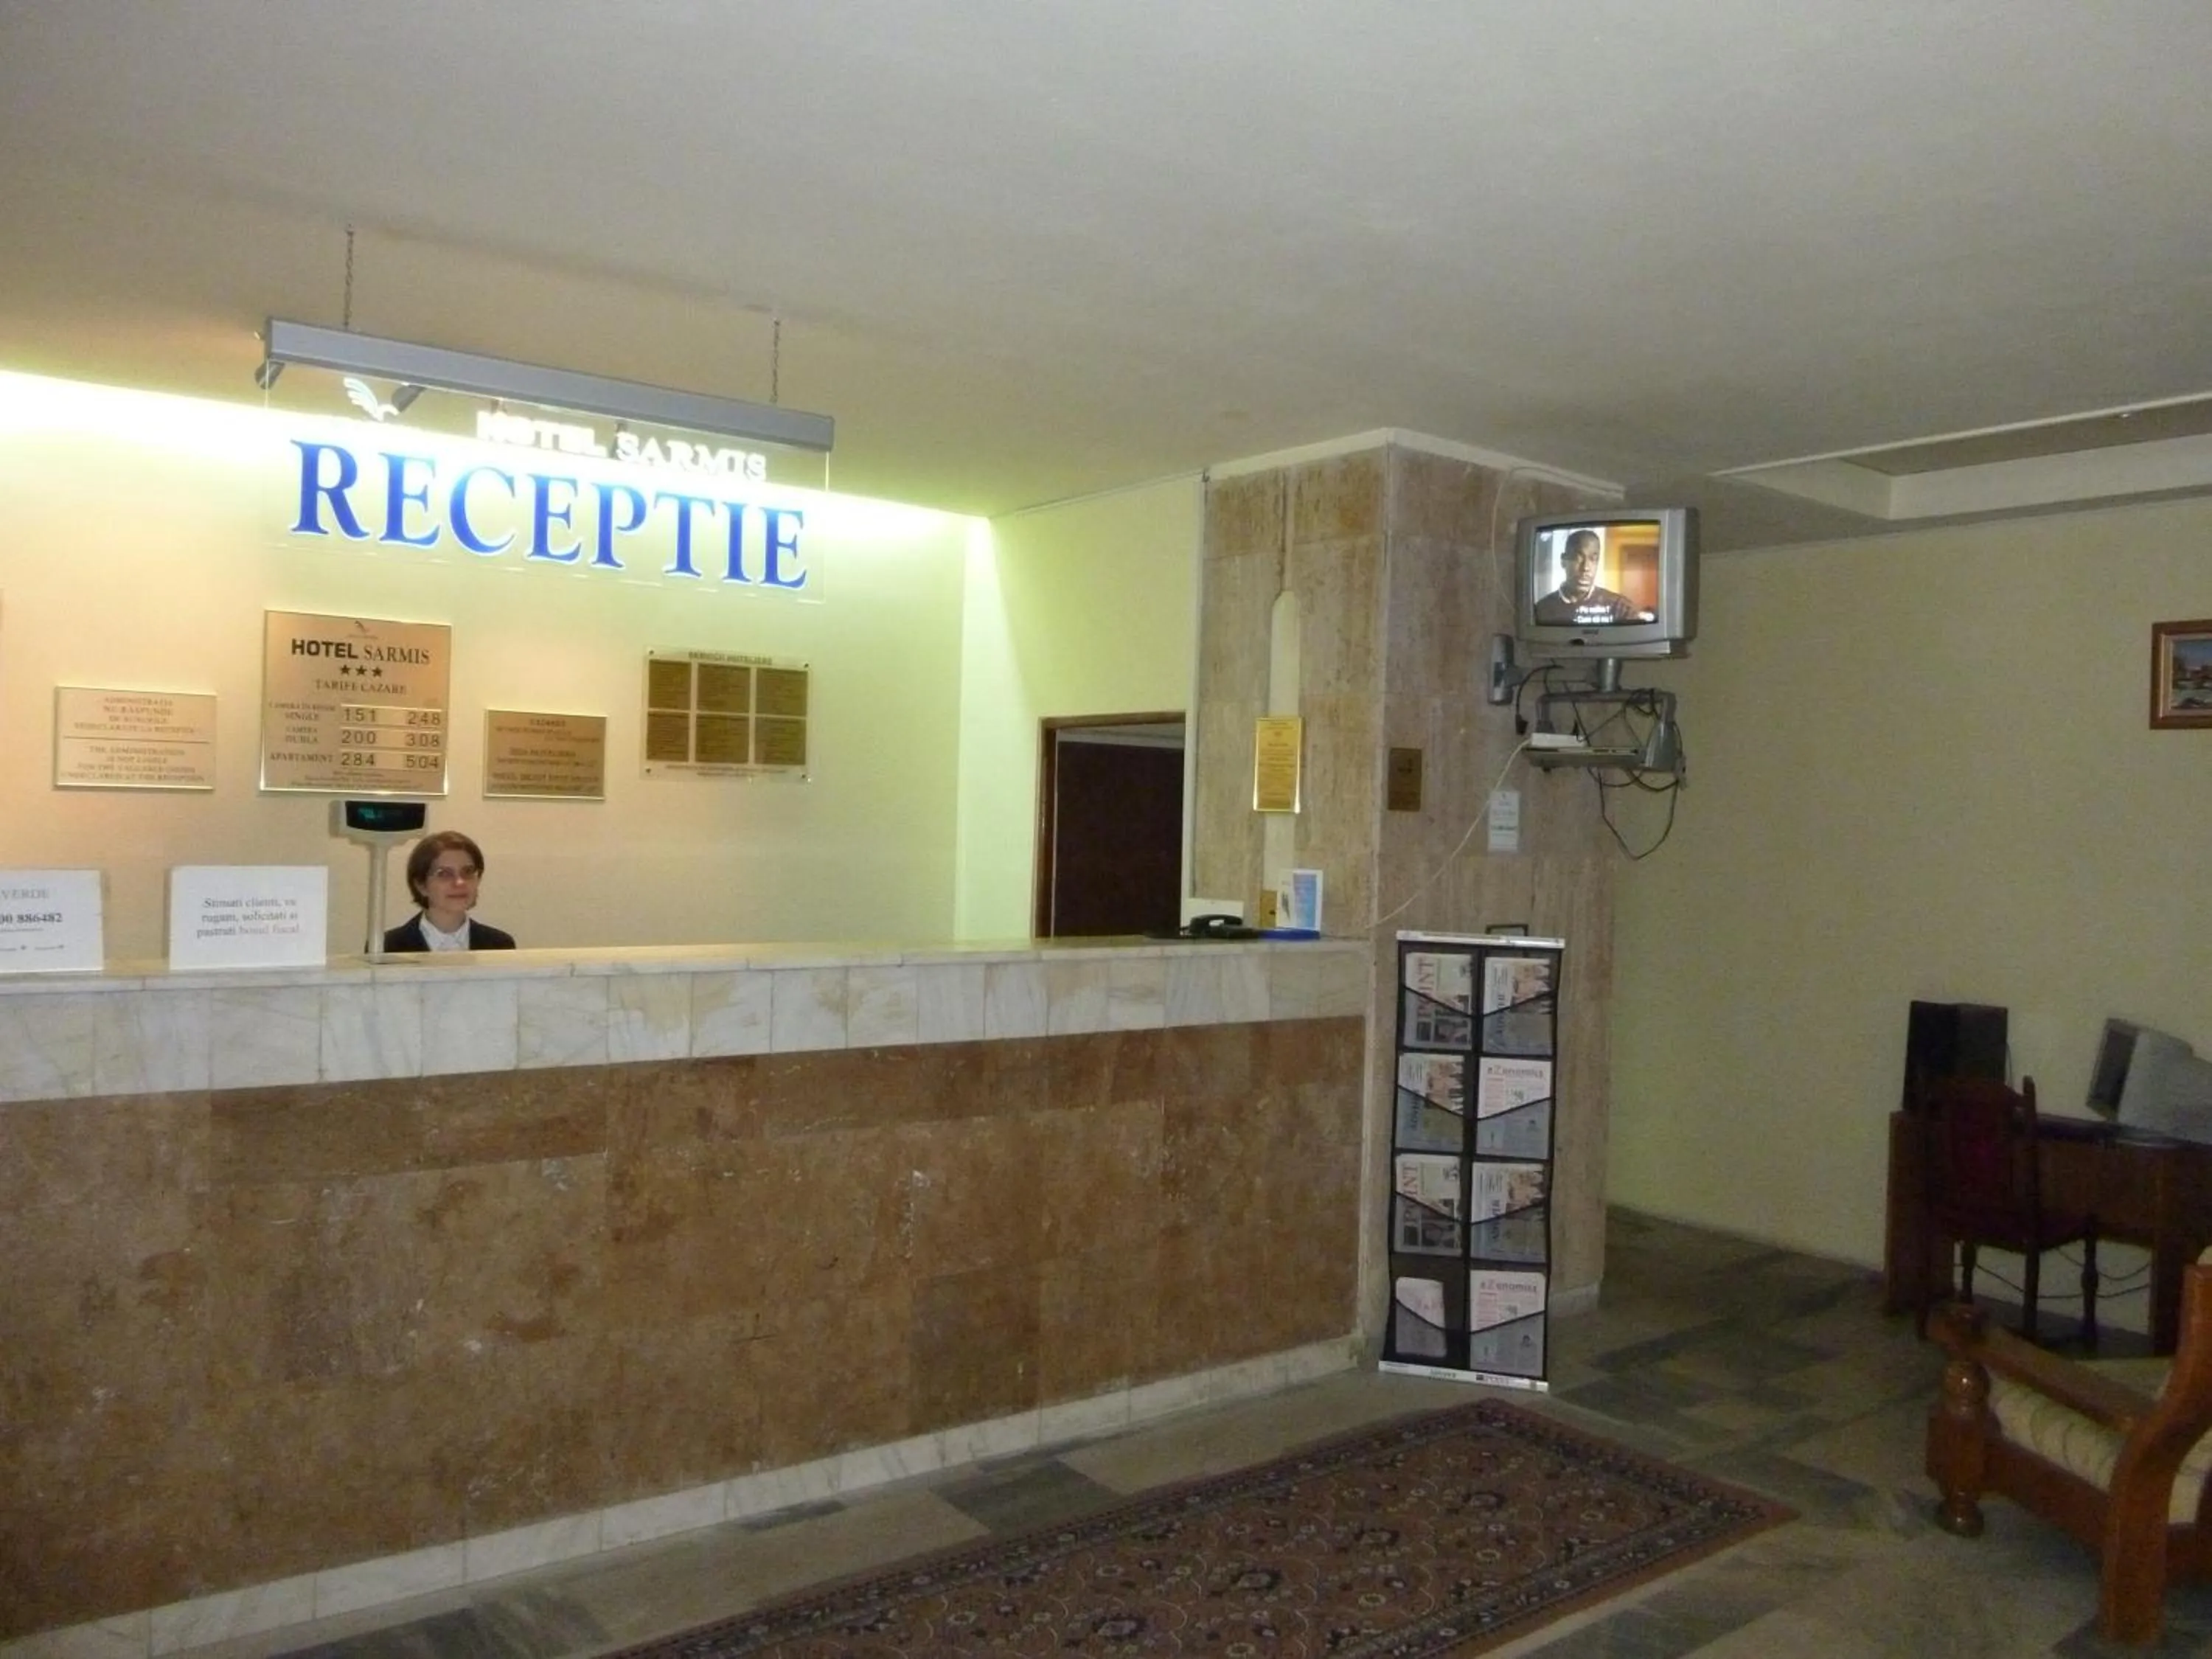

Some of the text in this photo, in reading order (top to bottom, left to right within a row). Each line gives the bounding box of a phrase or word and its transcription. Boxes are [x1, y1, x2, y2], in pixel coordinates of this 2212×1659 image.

[616, 431, 766, 481] SARMIS
[290, 439, 807, 588] RECEPTIE
[291, 639, 430, 664] HOTEL SARMIS
[343, 708, 376, 722] 151
[408, 711, 441, 726] 248
[341, 730, 376, 744] 200
[406, 733, 440, 748] 308
[270, 752, 333, 764] APARTAMENT
[341, 752, 375, 767] 284
[406, 755, 439, 770] 504
[1, 889, 49, 900] VERDE
[16, 913, 63, 923] 886482
